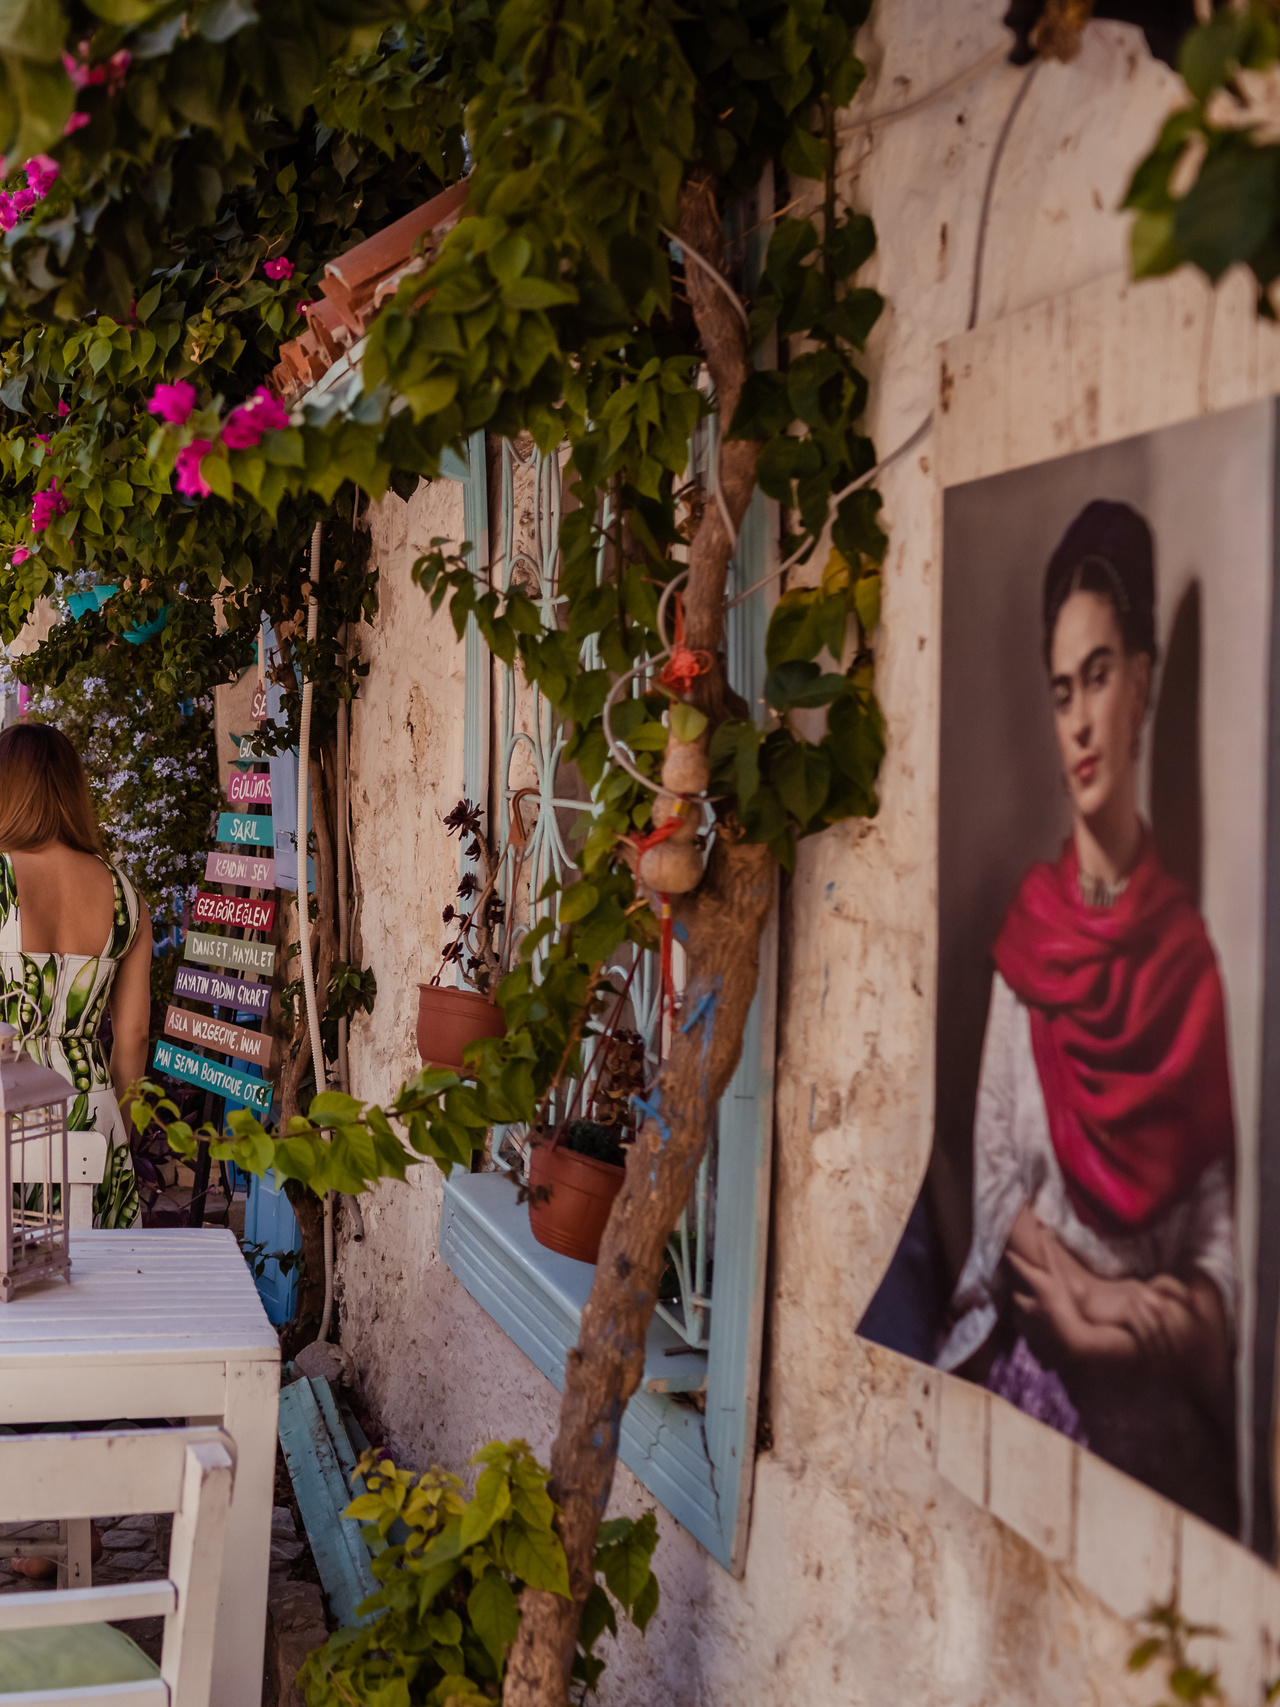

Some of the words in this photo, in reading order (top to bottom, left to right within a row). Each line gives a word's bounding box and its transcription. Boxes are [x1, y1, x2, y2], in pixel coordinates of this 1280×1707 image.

[231, 775, 272, 799] GÜLÜMS
[230, 818, 260, 842] SARIL
[251, 863, 270, 881] SEV
[176, 972, 210, 994] HAYATIN
[210, 979, 236, 1001] TADINI
[237, 985, 268, 1007] ÇIKART
[168, 1011, 188, 1032] ASLA
[240, 1030, 261, 1055] İNAN
[174, 1053, 199, 1076] SEMA
[200, 1062, 242, 1096] BOUTIQUE
